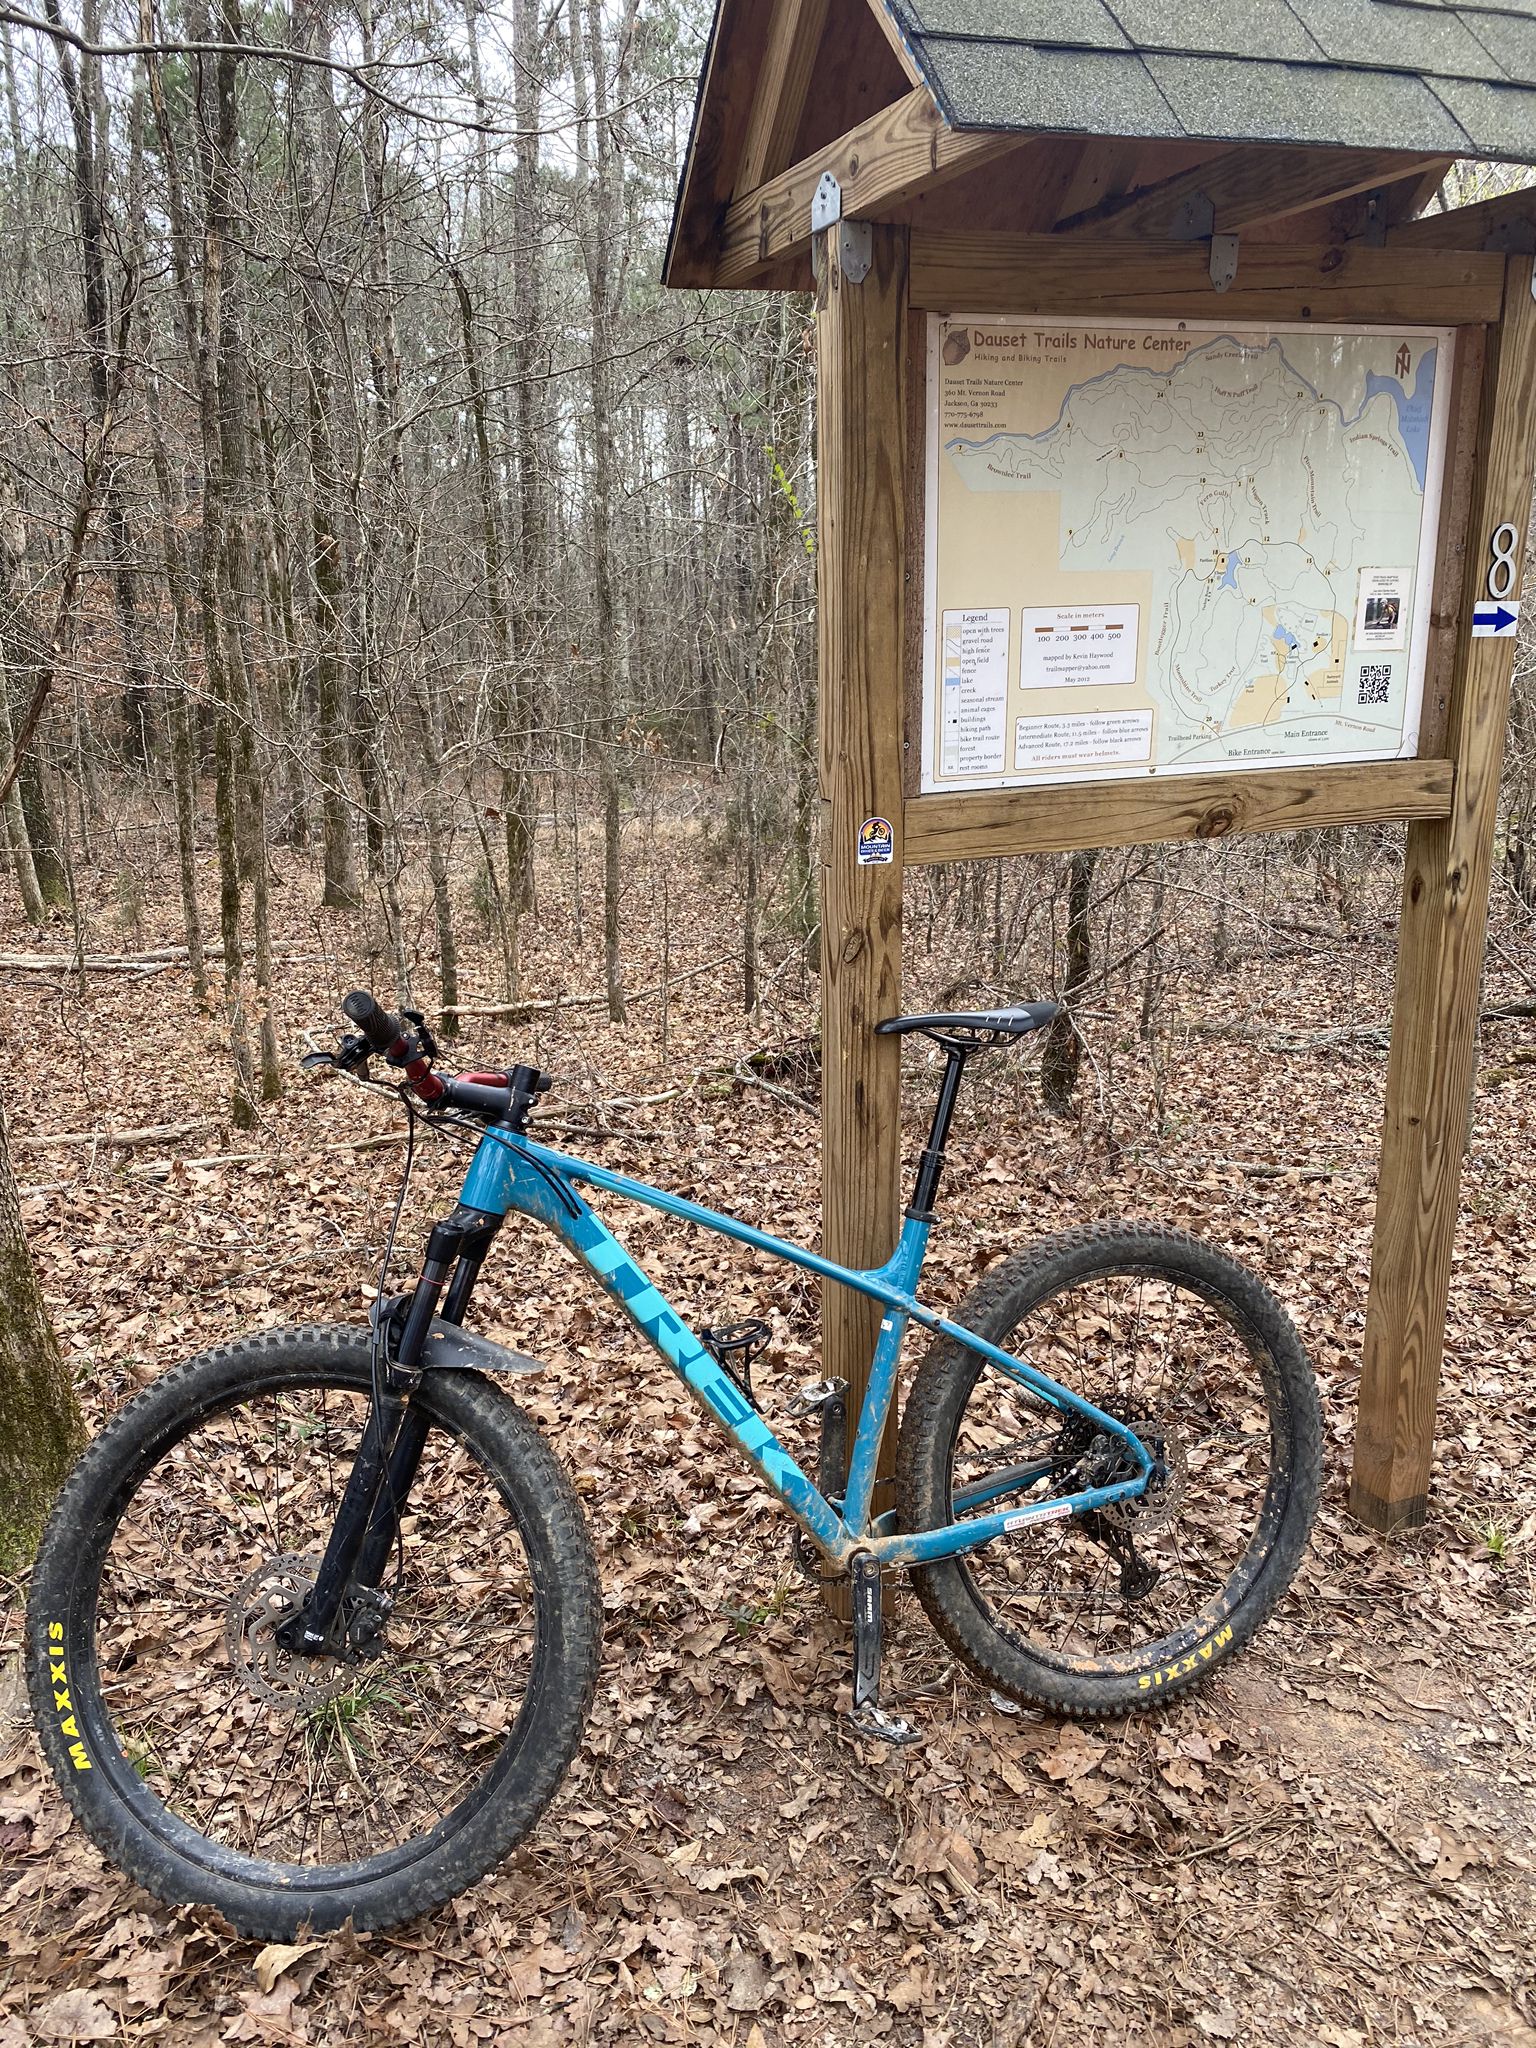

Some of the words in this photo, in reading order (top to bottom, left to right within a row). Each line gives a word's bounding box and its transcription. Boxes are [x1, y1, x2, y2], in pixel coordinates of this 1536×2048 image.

[974, 330, 1026, 347] Dauset
[1034, 332, 1077, 348] Trails
[1084, 334, 1135, 350] Nature
[1143, 335, 1191, 351] Center
[974, 354, 998, 363] Hiking
[1002, 354, 1015, 362] and
[1018, 355, 1041, 363] Biking
[1045, 355, 1067, 363] Trails
[944, 400, 969, 408] Jackson,
[1349, 434, 1368, 444] Indian
[1369, 433, 1388, 447] Springs
[1387, 445, 1399, 457] Trail
[987, 463, 1014, 479] Brownlee
[1309, 470, 1317, 503] Mountain
[1200, 492, 1213, 506] Fern
[1214, 490, 1229, 499] Gully
[1311, 502, 1322, 518] Trail
[1487, 523, 1518, 599] 8
[963, 613, 988, 623] Legend
[1073, 634, 1087, 642] 300
[1090, 633, 1104, 641] 400
[1089, 652, 1113, 660] Haywood
[1046, 664, 1110, 672] trailmapper@yahoo.com
[1210, 679, 1227, 692] Turkey
[1226, 666, 1236, 678] Trot
[1191, 691, 1202, 702] Trail
[1344, 721, 1362, 730] Vernon
[1018, 733, 1052, 741] Intermediate
[1244, 748, 1271, 756] Entrance
[584, 1214, 808, 1491] TREK
[1138, 1624, 1233, 1689] MAXXIS
[49, 1621, 92, 1770] MAXXIS
